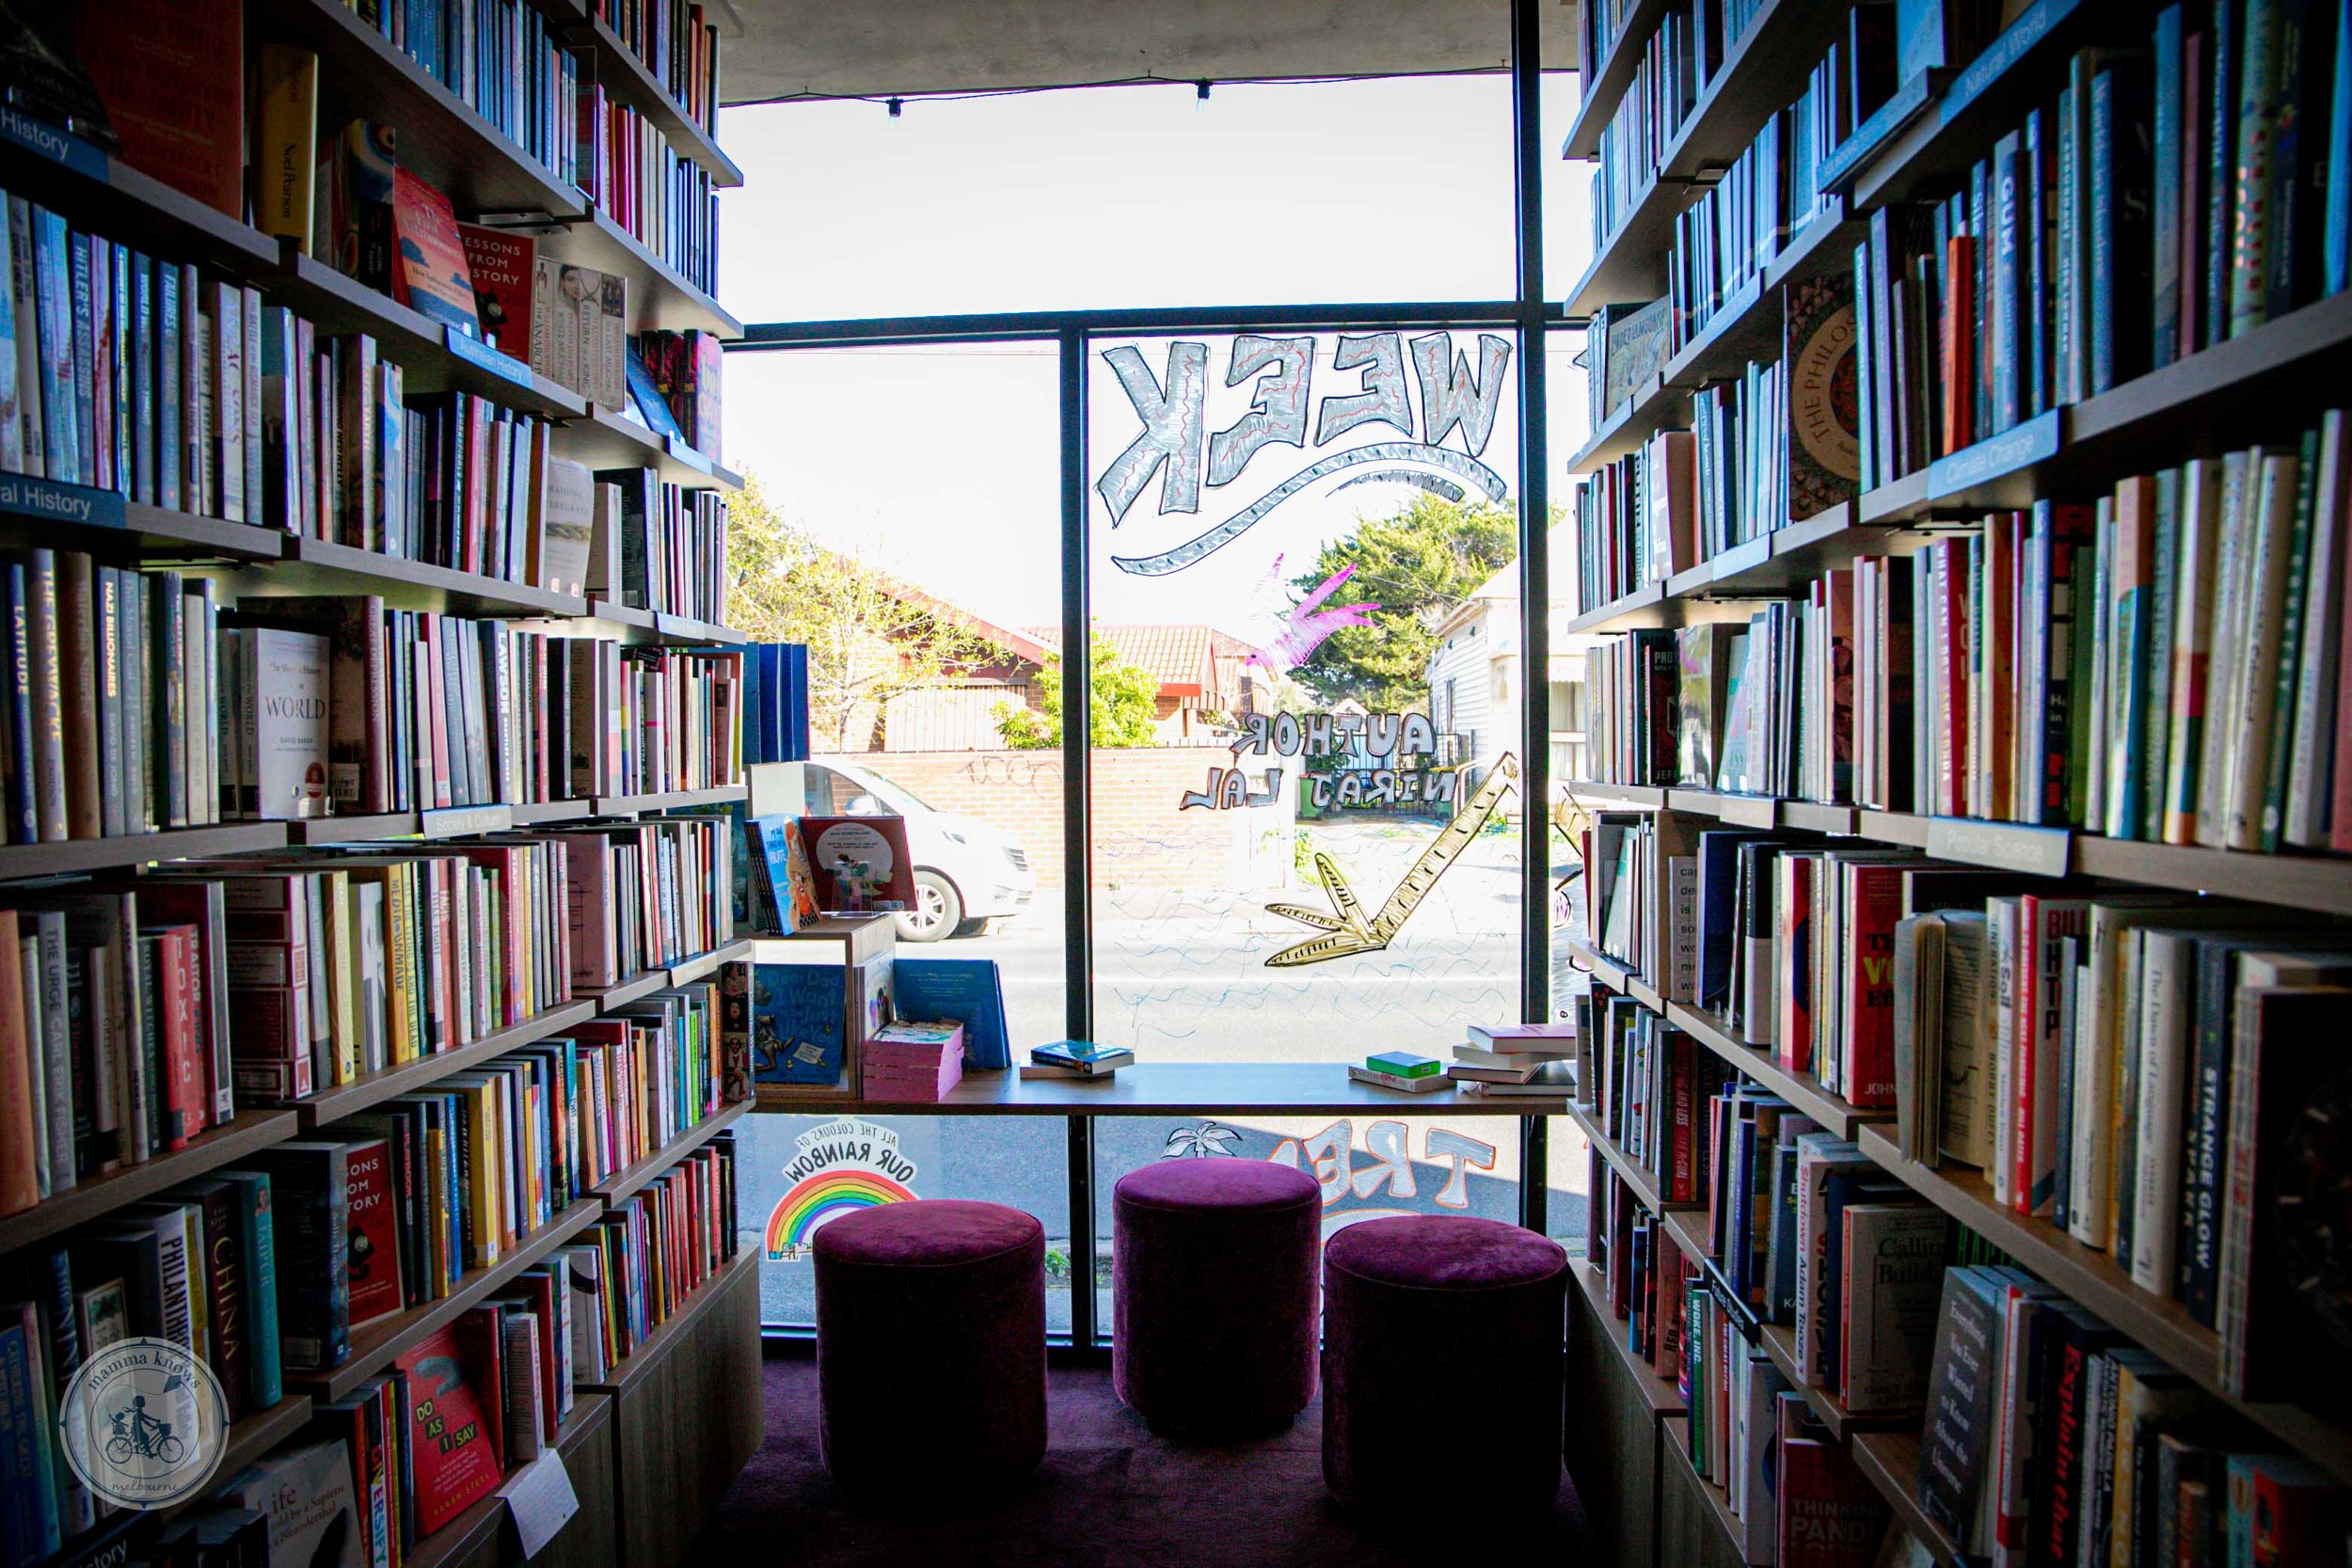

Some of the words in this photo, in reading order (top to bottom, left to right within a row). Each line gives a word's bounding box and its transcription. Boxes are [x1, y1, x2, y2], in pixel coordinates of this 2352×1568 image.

[1, 105, 70, 161] History
[285, 143, 297, 174] Noel
[282, 174, 296, 217] Pearson
[2001, 176, 2016, 255] GUM
[465, 237, 520, 256] ESSONS
[469, 252, 508, 269] FROM
[74, 245, 90, 318] HITLER'S
[473, 269, 520, 286] STORY
[75, 319, 92, 399] ASSASSINS
[1804, 398, 1831, 444] THE
[24, 478, 91, 518] History
[1634, 455, 1643, 528] PUTIN
[103, 581, 115, 613] NAZI
[13, 605, 29, 696] LATITUDE
[105, 615, 117, 697] BILLIONAIRES
[498, 632, 510, 714] LAWSON
[108, 713, 118, 746] DAVID
[244, 696, 255, 736] WORLD
[264, 696, 326, 720] WORLD
[389, 879, 401, 924] MEDIA
[47, 928, 60, 961] THE
[190, 929, 200, 1002] TRAITOR
[393, 934, 405, 992] UNMADE
[48, 964, 63, 1011] URGE
[2151, 970, 2163, 997] The
[51, 1017, 66, 1063] CARL
[144, 994, 155, 1058] WITCHES
[408, 1021, 418, 1048] DEAD
[1988, 1052, 1996, 1101] BOBBY
[2149, 1053, 2161, 1067] of
[53, 1067, 67, 1103] ERIK
[54, 1108, 70, 1164] FISHER
[1677, 1105, 1690, 1126] LESS
[1987, 1104, 1995, 1147] DUFFY
[2199, 1067, 2218, 1185] STRANGE
[1798, 1165, 1809, 1253] Shutdown
[2196, 1191, 2214, 1269] GLOW
[213, 1235, 242, 1361] CHINA
[1798, 1255, 1806, 1308] Adam
[1797, 1311, 1806, 1360] Tooze
[416, 1400, 435, 1423] DO
[426, 1418, 444, 1438] AS
[2054, 1342, 2083, 1481] Explain
[455, 1423, 478, 1448] SAY
[269, 1482, 297, 1515] ife
[370, 1444, 389, 1565] DIVERSIFY
[1790, 1498, 1880, 1516] THINKIN
